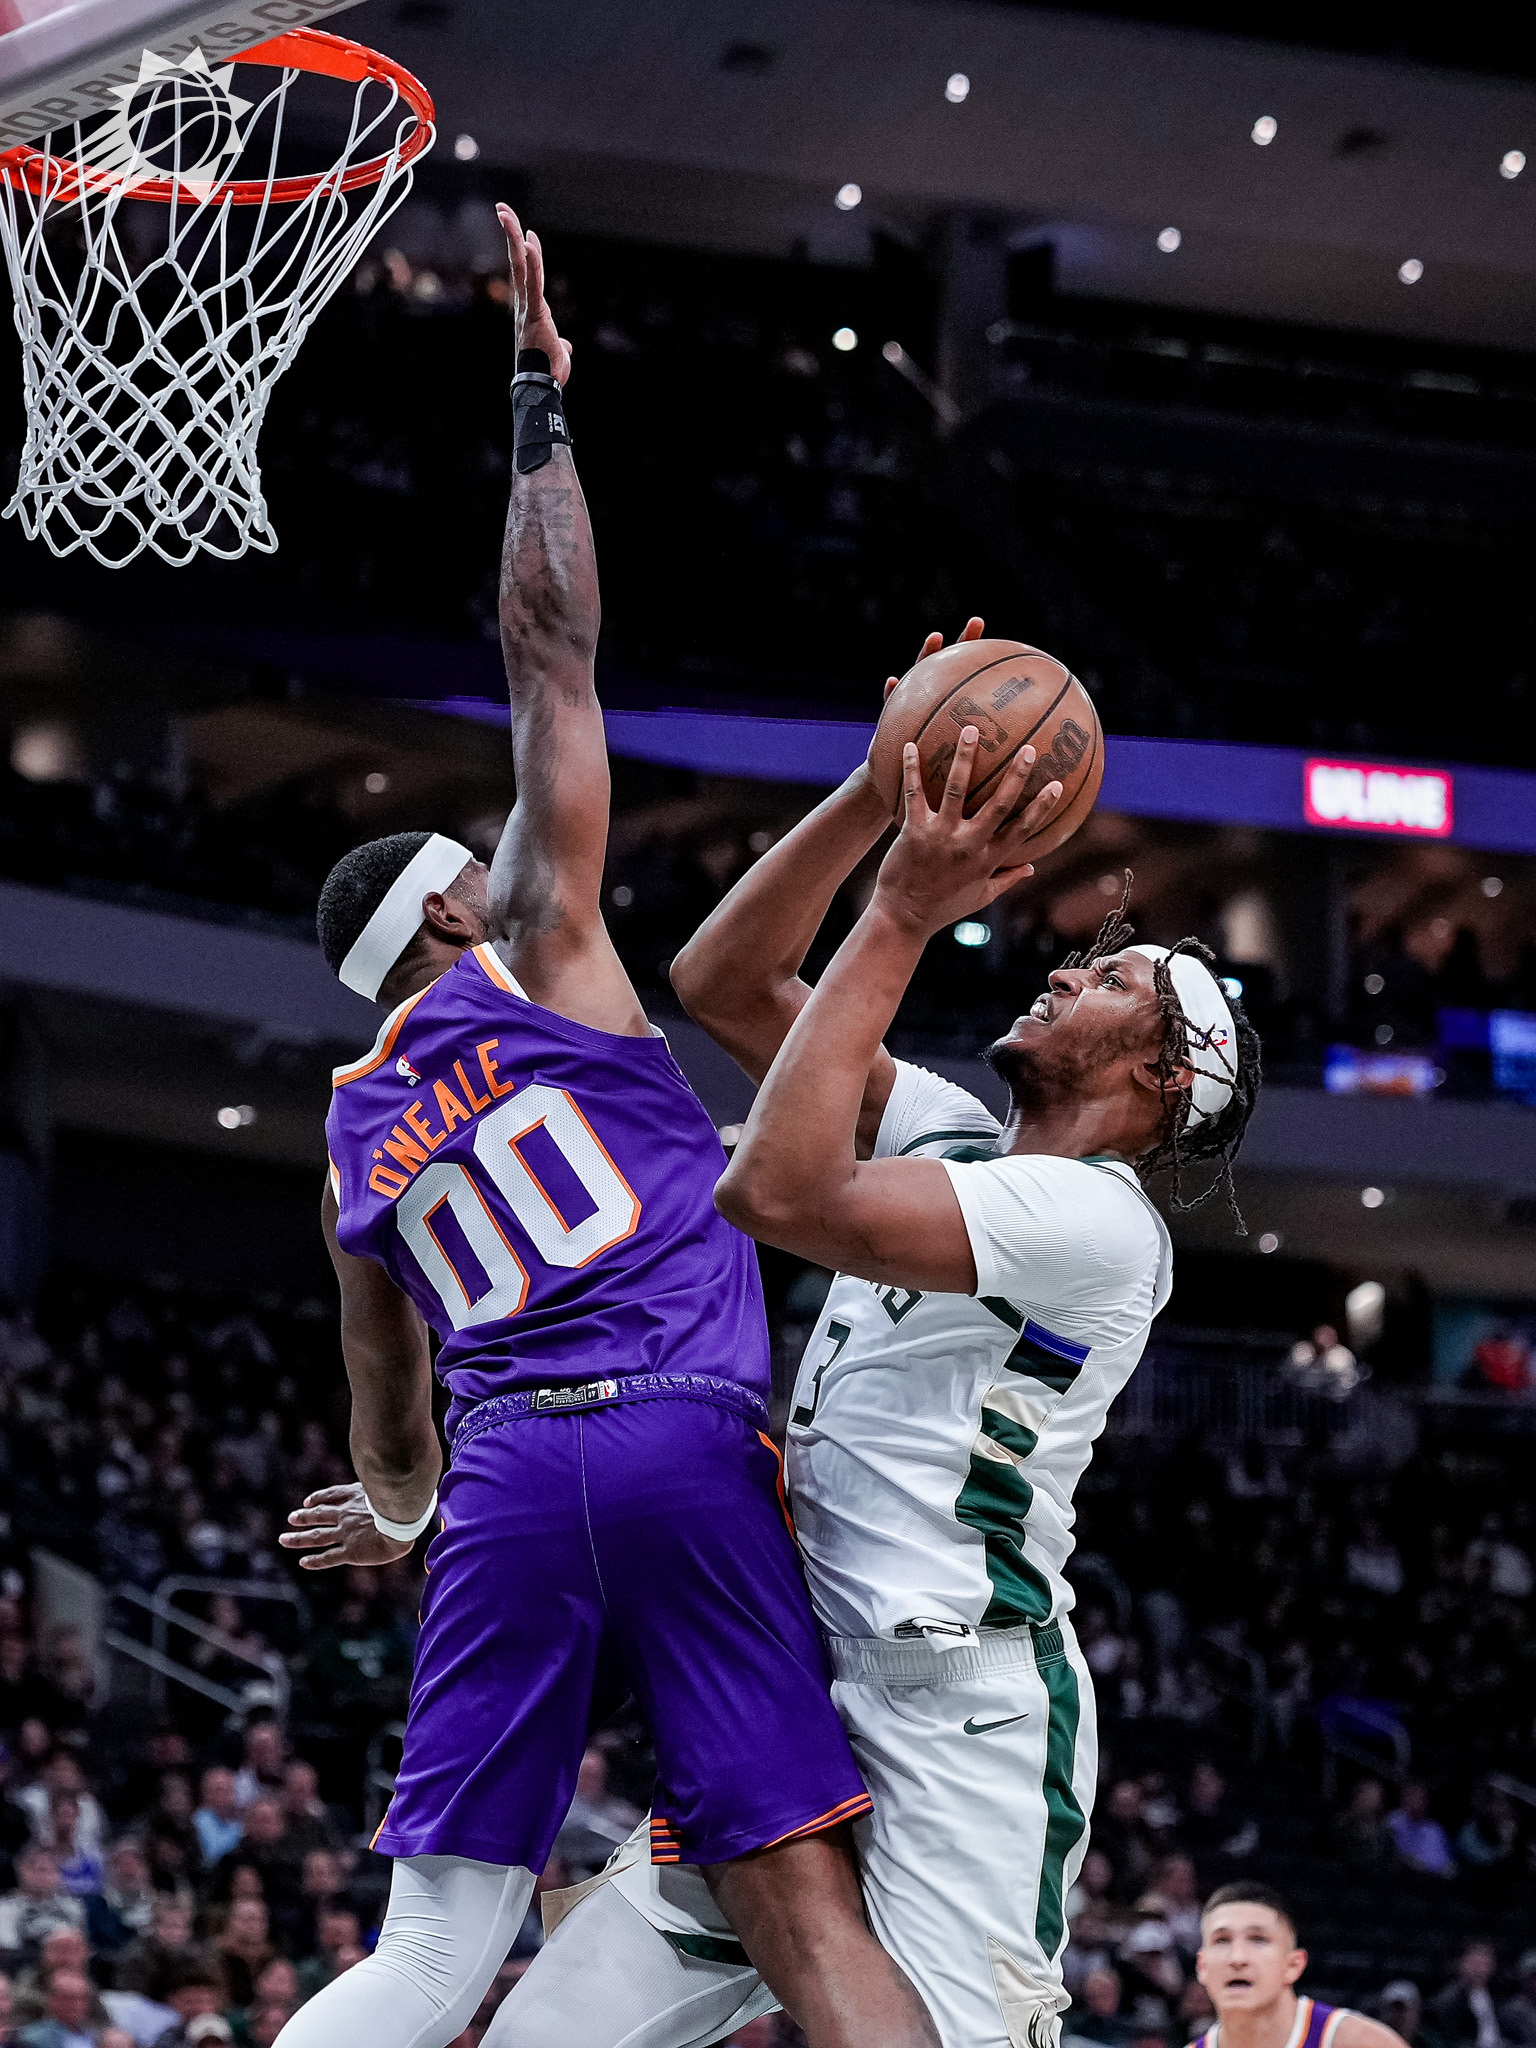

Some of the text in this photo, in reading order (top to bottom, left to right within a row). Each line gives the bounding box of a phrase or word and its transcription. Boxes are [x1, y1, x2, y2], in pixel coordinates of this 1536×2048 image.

[368, 1038, 515, 1200] O'NEALE
[395, 1083, 643, 1332] 00
[790, 1319, 853, 1428] 3
